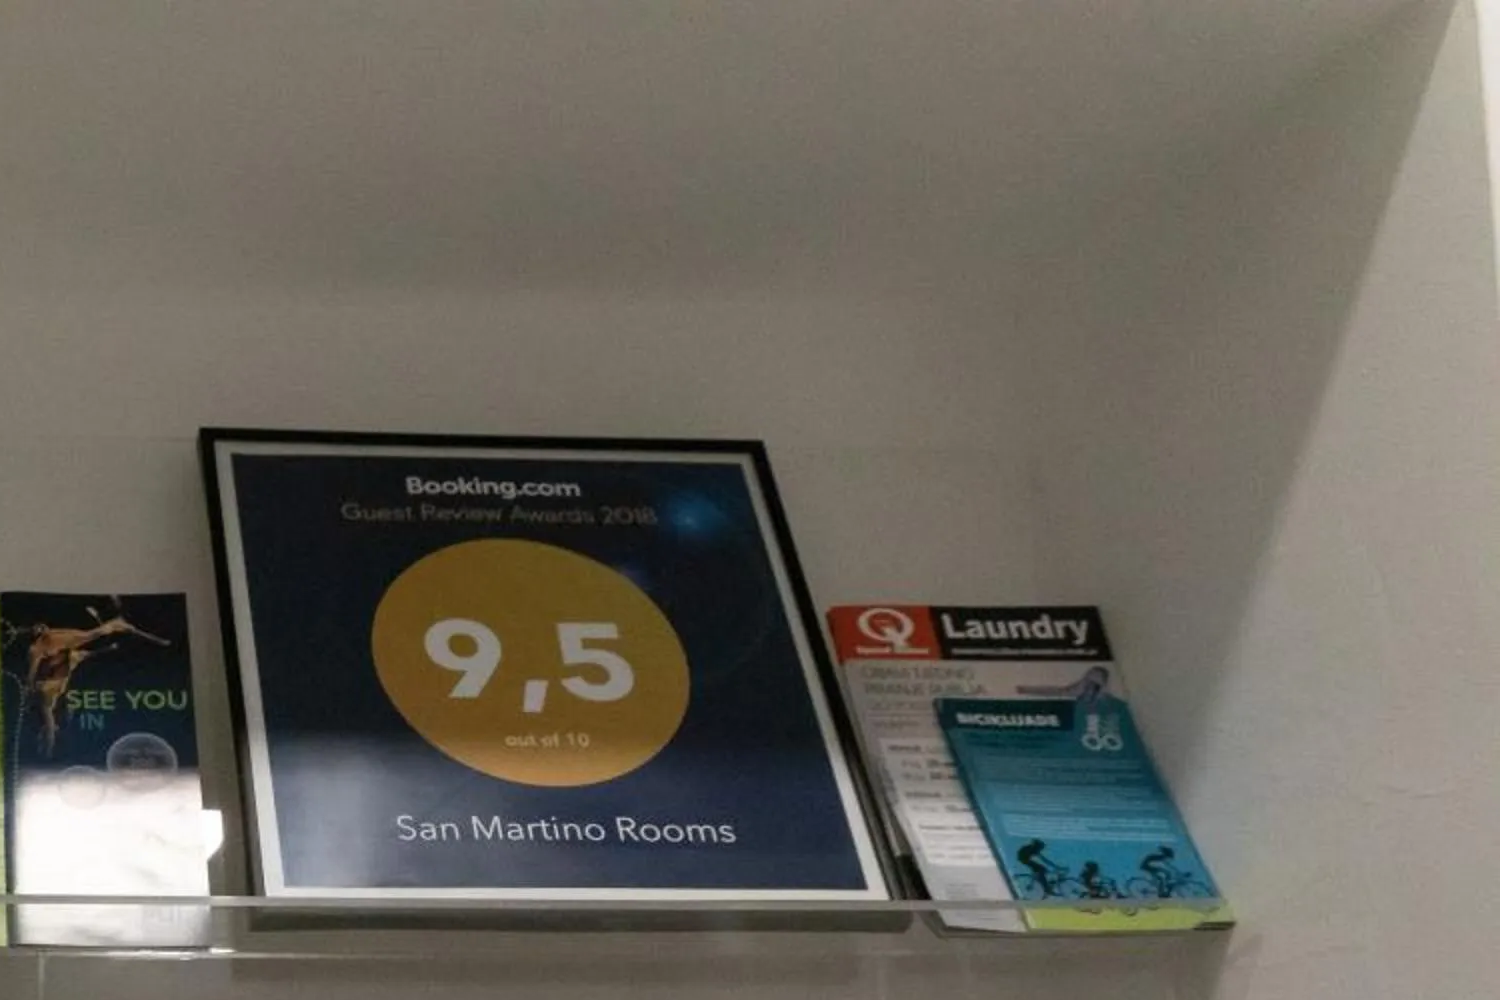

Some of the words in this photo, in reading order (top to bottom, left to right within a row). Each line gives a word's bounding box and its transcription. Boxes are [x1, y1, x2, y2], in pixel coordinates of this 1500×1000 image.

[405, 475, 581, 499] Booking.com
[341, 502, 412, 521] Guest
[420, 503, 502, 522] Review
[510, 505, 595, 524] Awards
[601, 507, 658, 525] 2018
[941, 612, 1088, 645] Laundry
[423, 618, 634, 714] 9,5
[67, 689, 115, 710] SEE
[126, 689, 188, 711] YOU
[80, 714, 105, 730] IN
[504, 733, 535, 747] out
[539, 731, 559, 747] of
[566, 732, 589, 747] 10
[396, 815, 459, 842] San
[473, 815, 606, 842] Martino
[619, 817, 736, 845] Rooms
